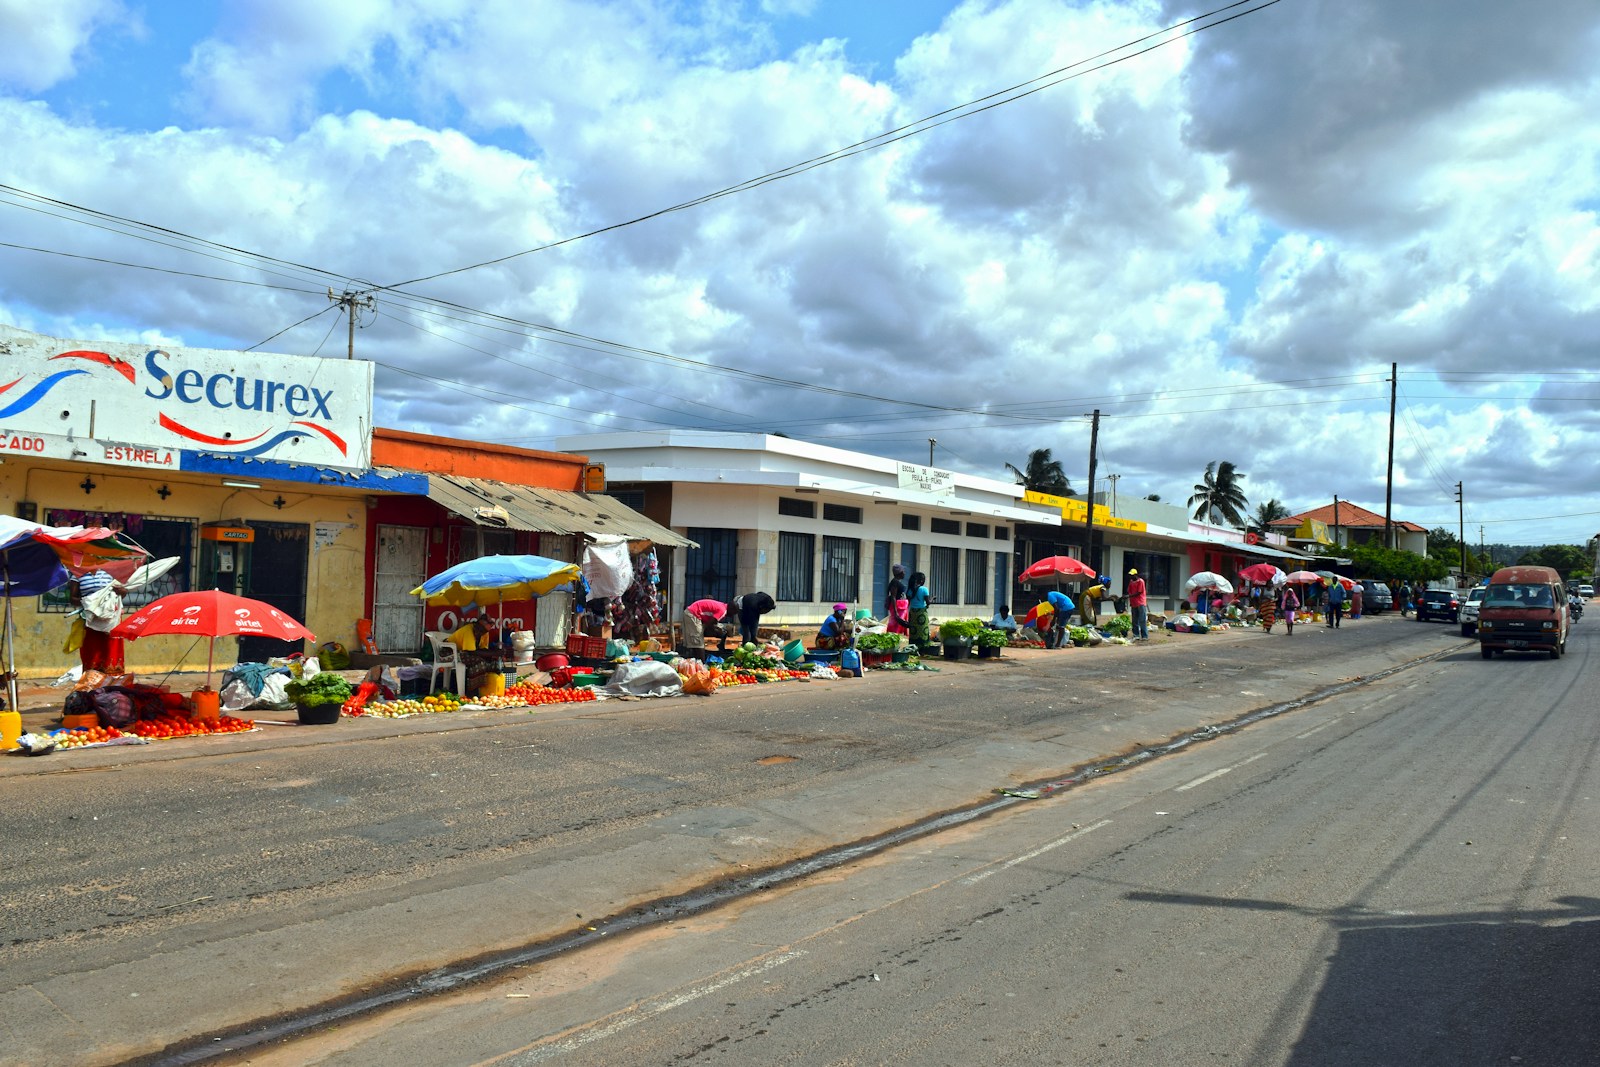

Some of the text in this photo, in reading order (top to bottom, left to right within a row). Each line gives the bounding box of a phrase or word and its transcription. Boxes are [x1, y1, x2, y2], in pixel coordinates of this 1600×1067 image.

[144, 350, 334, 421] Securex
[105, 446, 173, 465] ESTRELA
[171, 617, 262, 628] airtel airtel
